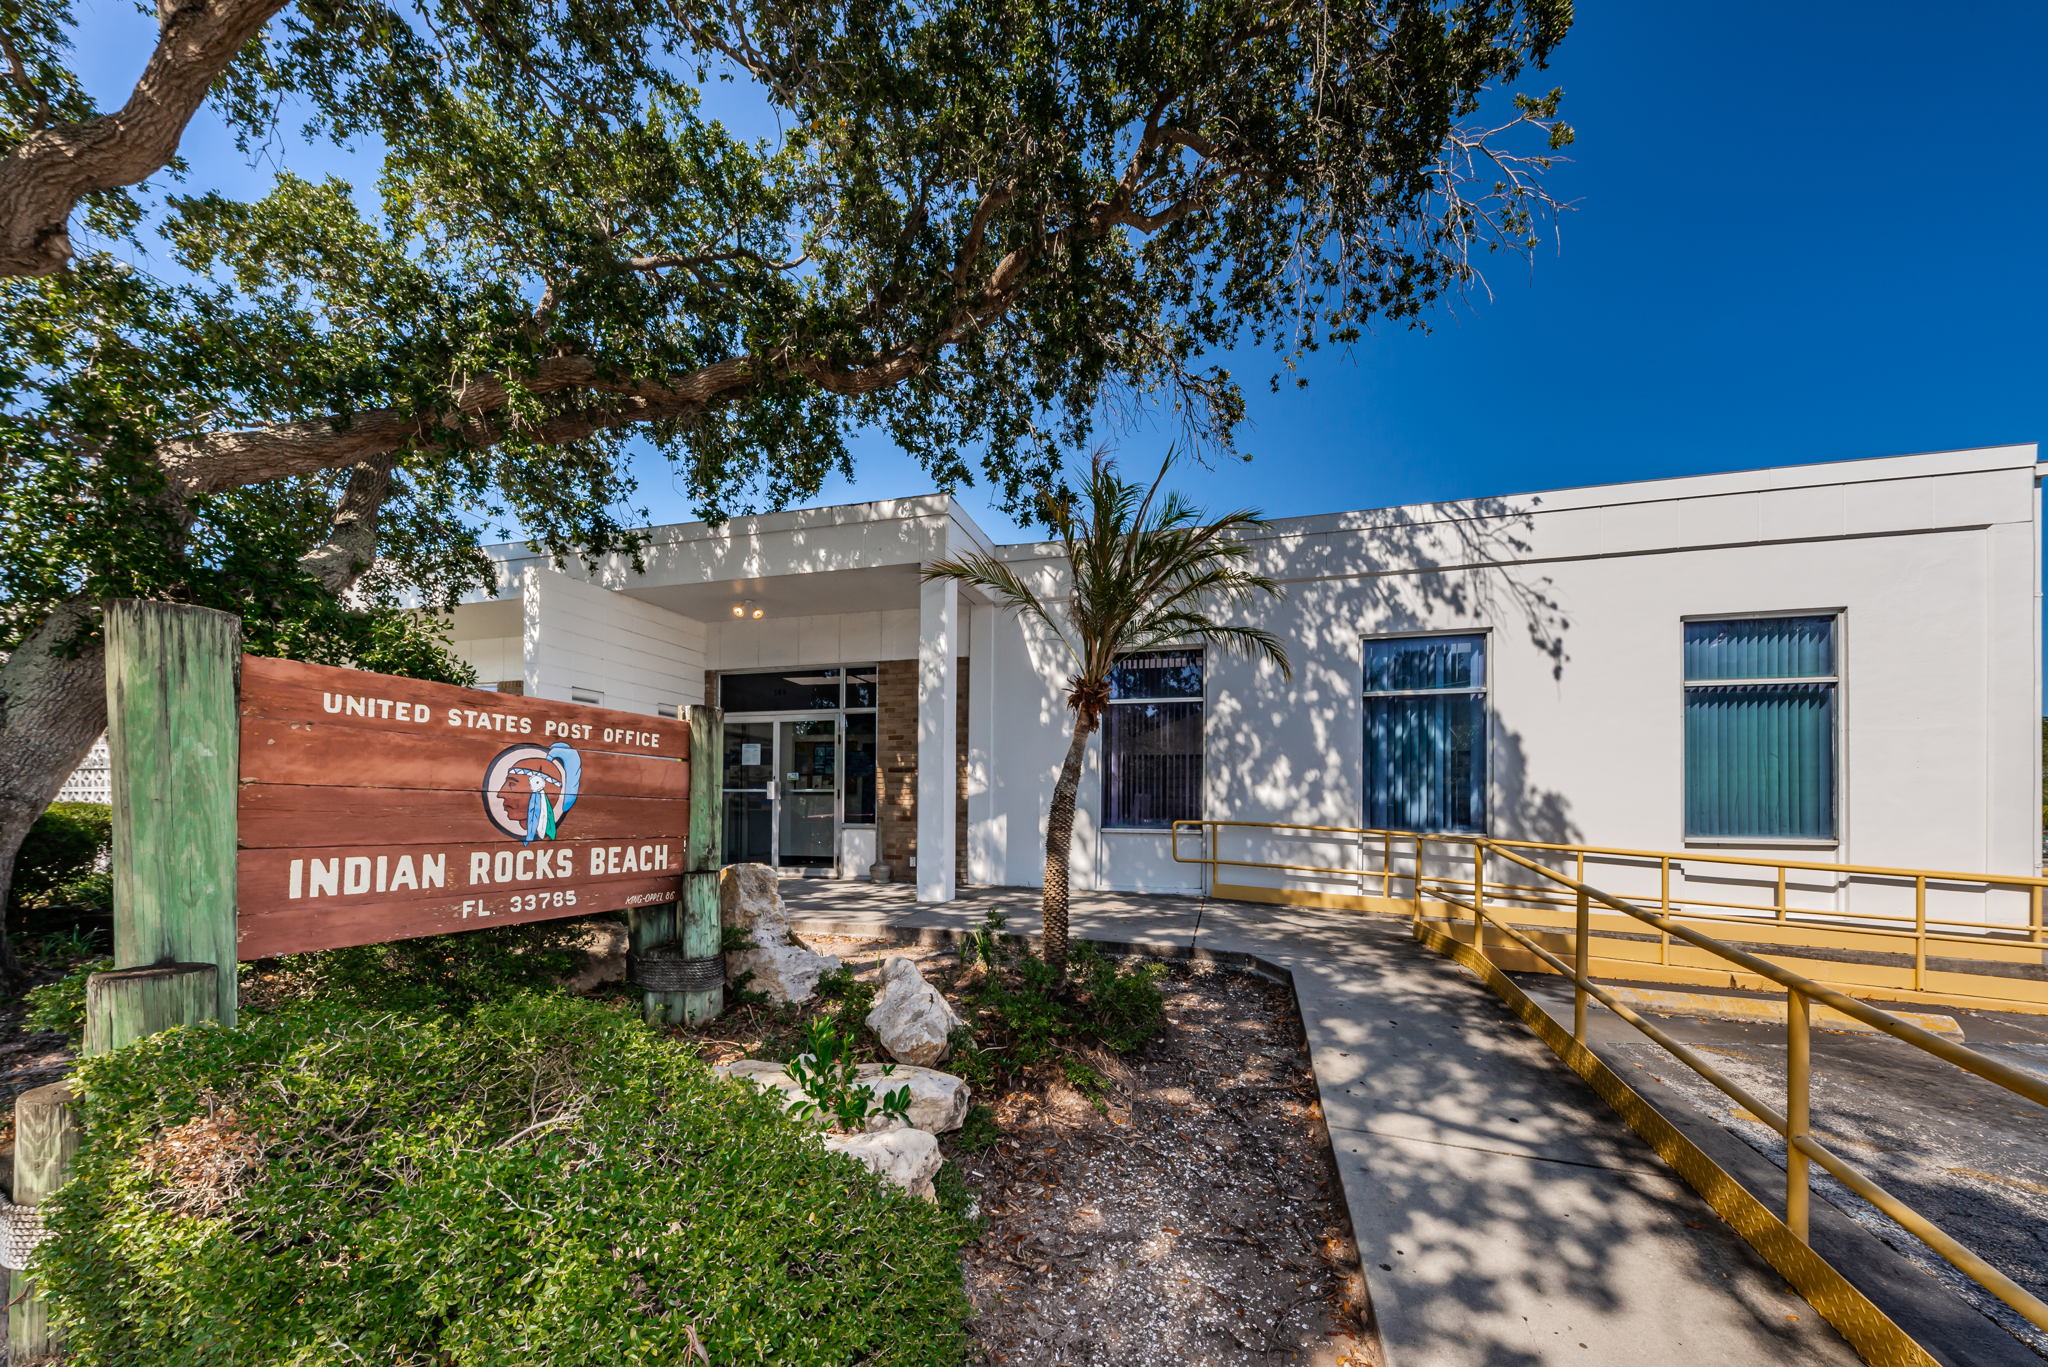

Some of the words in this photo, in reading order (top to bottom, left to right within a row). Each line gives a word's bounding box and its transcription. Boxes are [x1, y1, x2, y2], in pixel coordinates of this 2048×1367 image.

[323, 692, 430, 723] UNITED
[448, 708, 532, 734] STATES
[545, 720, 593, 740] POST
[603, 728, 660, 748] OFFICE
[289, 853, 446, 899] INDIAN
[469, 848, 573, 885] ROCKS
[590, 844, 668, 876] BEACH
[462, 899, 496, 919] FL.
[510, 890, 577, 912] 33785
